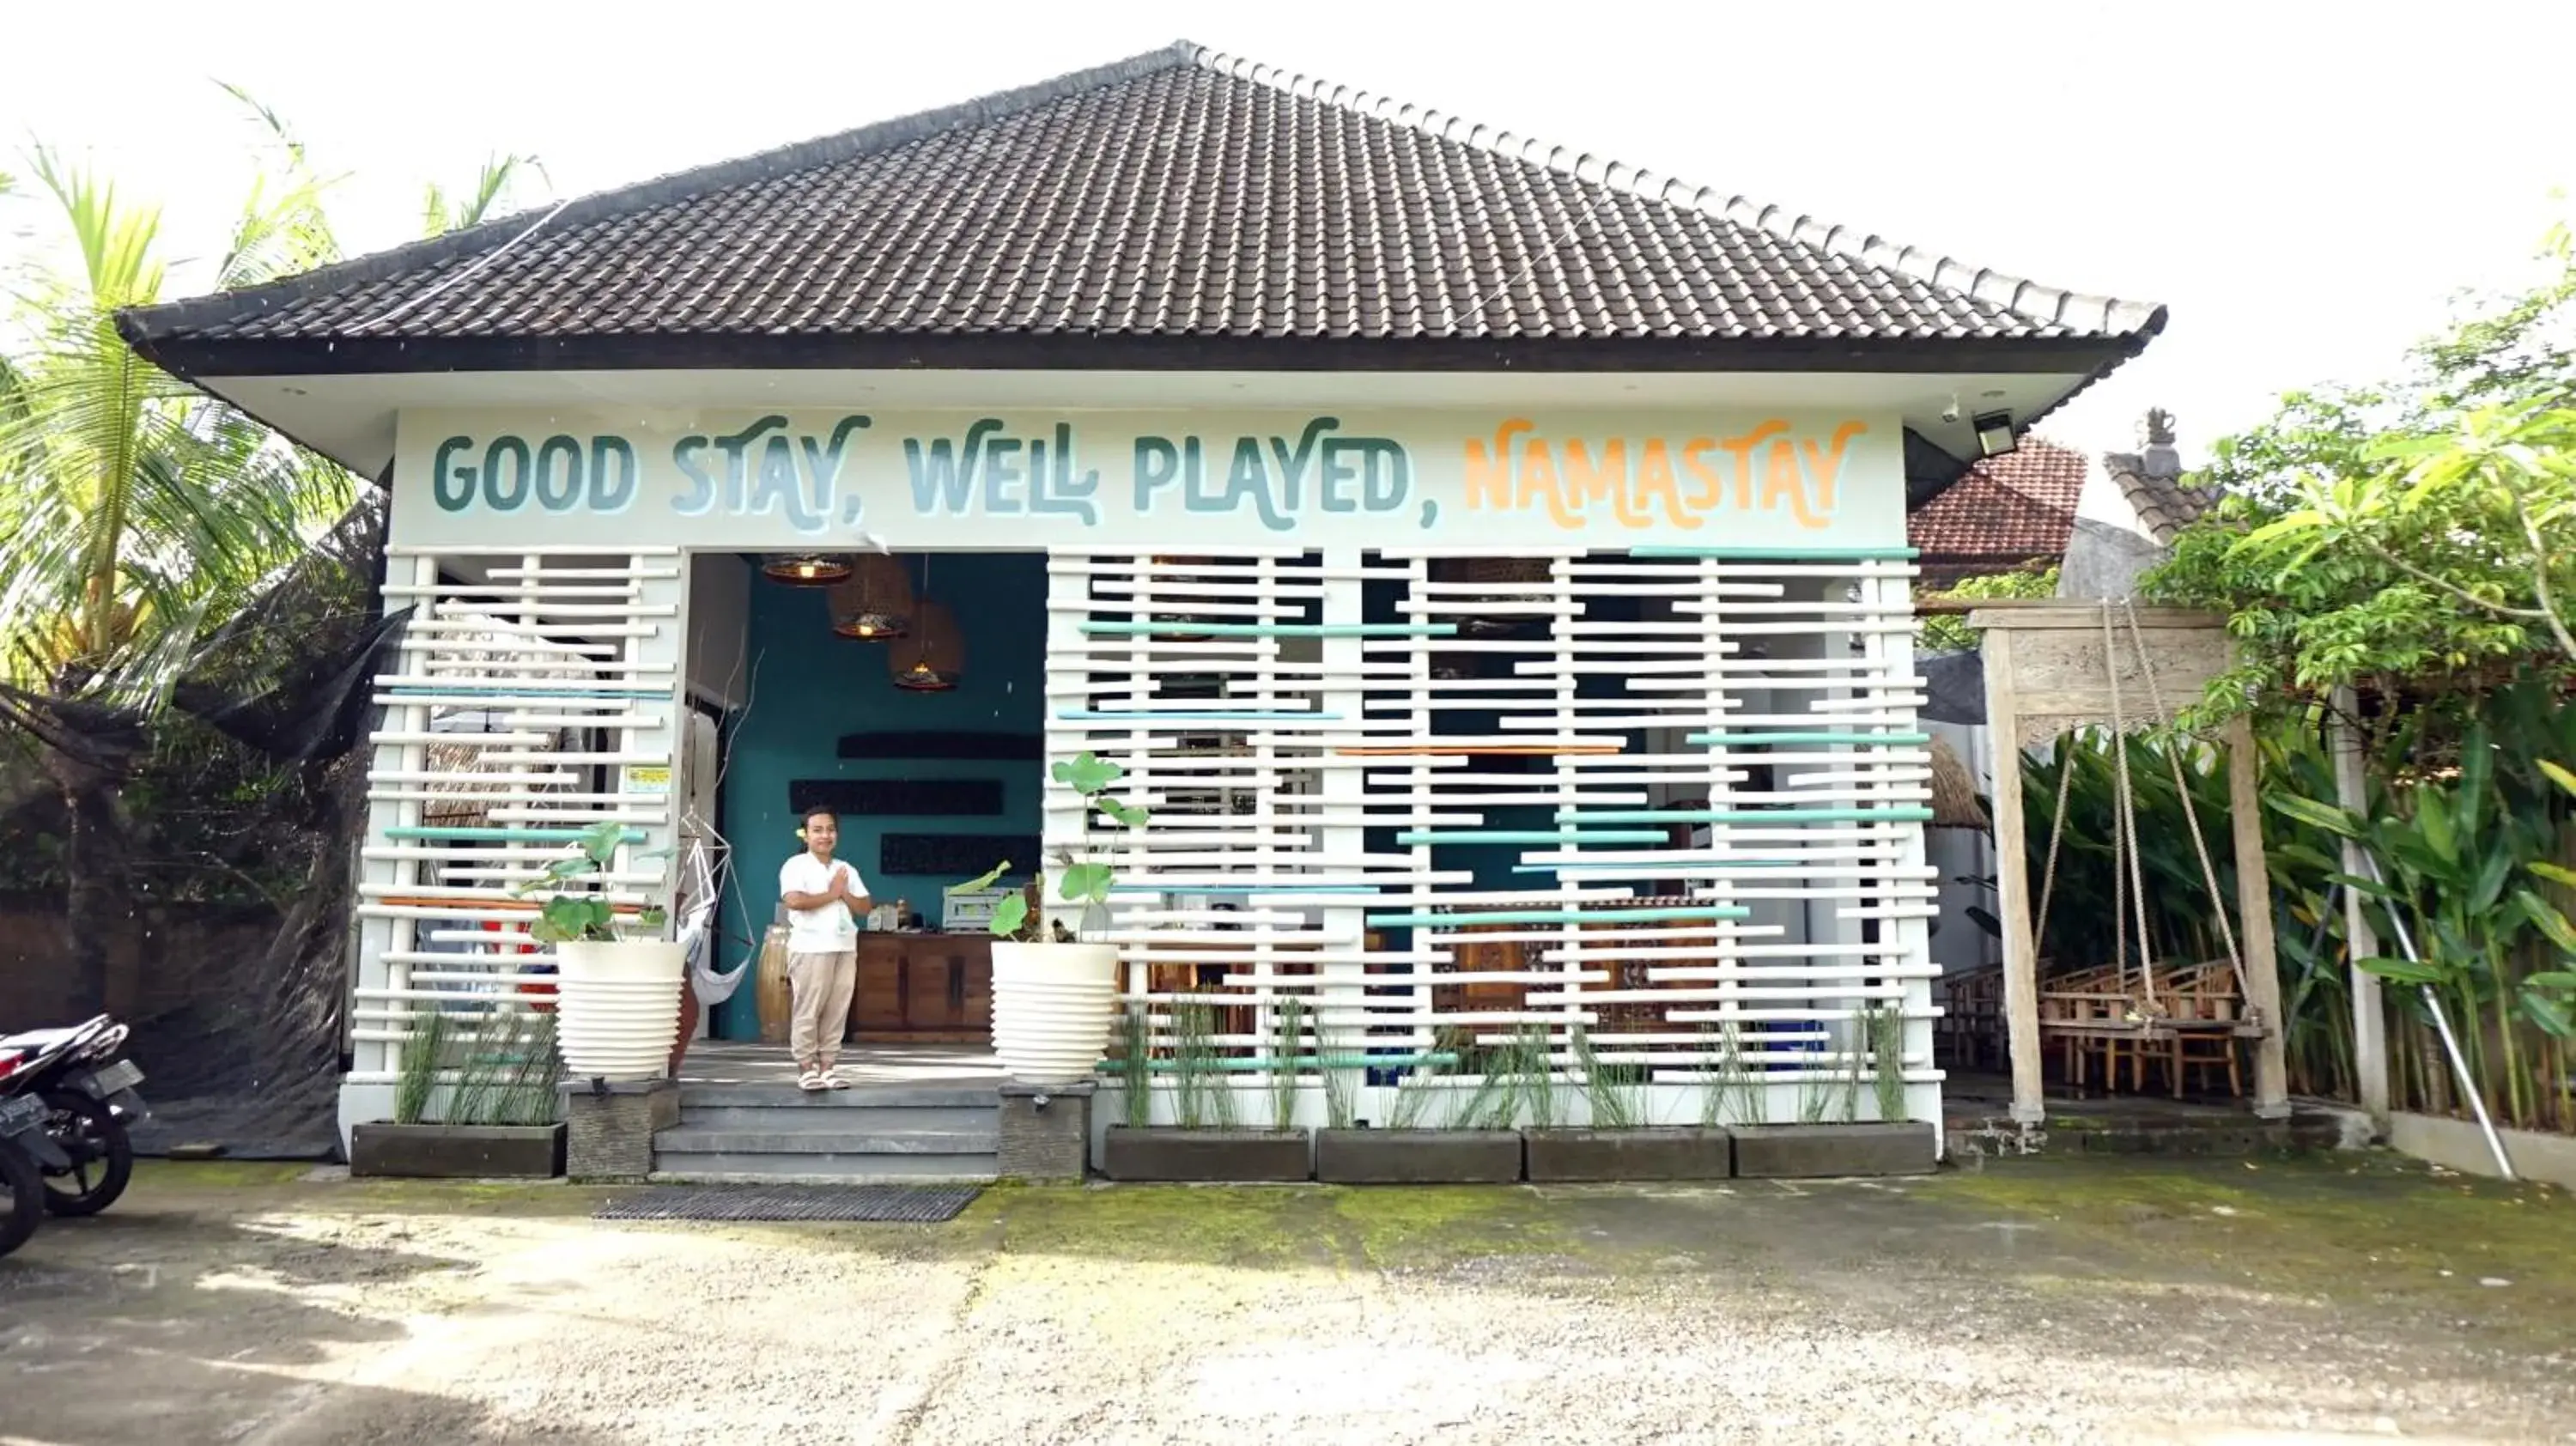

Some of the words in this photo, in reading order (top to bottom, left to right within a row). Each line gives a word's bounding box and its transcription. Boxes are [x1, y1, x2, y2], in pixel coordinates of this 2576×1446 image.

[434, 434, 637, 513] GOOD
[670, 415, 872, 532] STAY,
[903, 418, 1101, 526] WELL
[1133, 416, 1438, 531] PLAYED,
[1465, 417, 1869, 530] NAMASTAY
